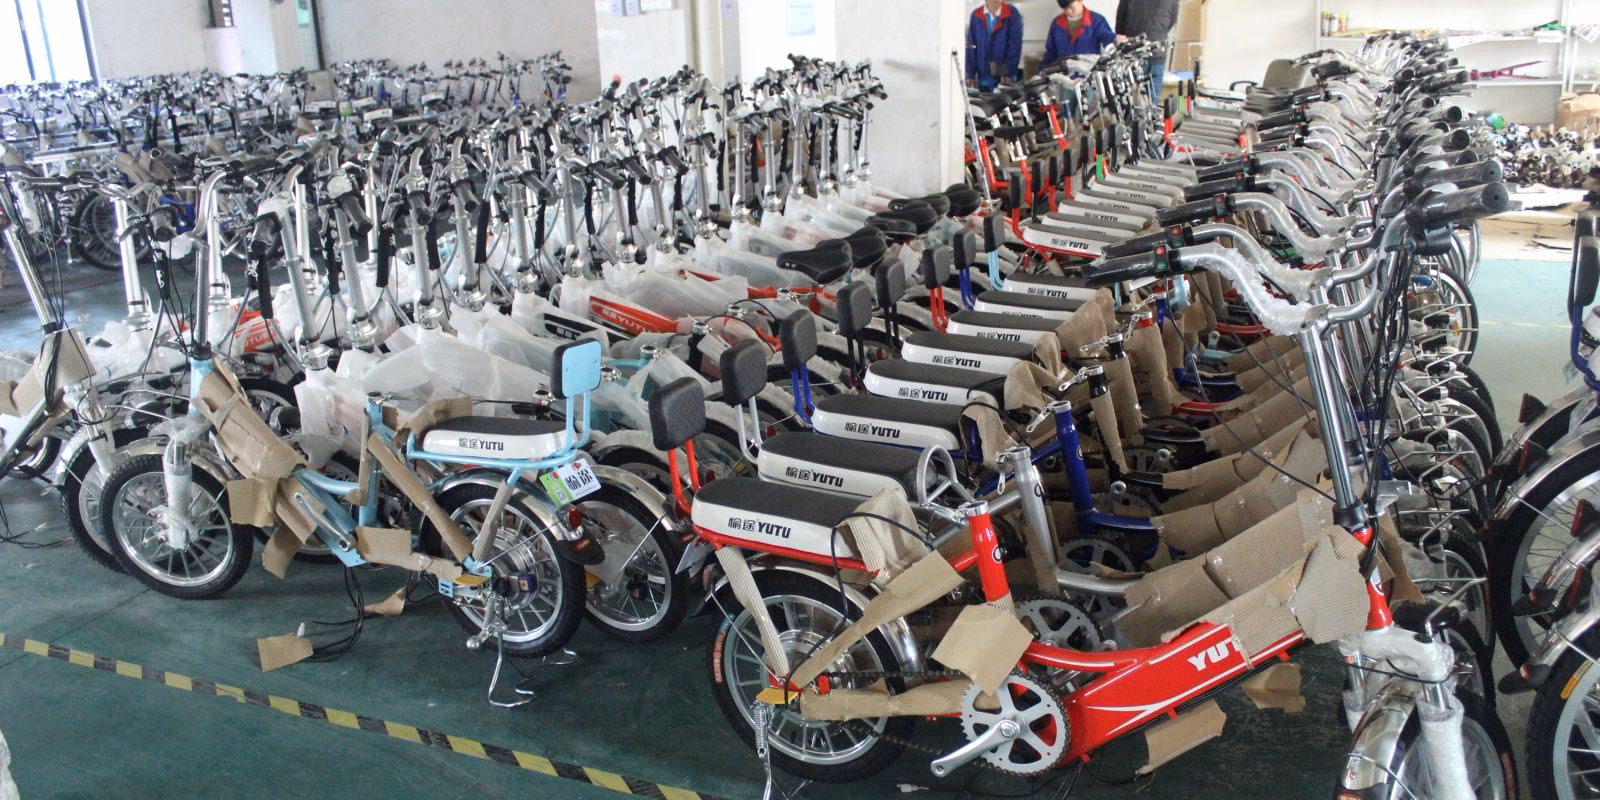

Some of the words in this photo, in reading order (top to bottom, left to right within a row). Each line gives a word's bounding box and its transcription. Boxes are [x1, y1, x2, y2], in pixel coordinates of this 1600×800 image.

[1068, 240, 1089, 250] YUTU
[1046, 289, 1068, 299] YUTU
[997, 333, 1020, 341] YUTU
[955, 357, 981, 368] YUTU
[922, 390, 948, 401] YUTU
[871, 426, 900, 438] YUTU
[480, 440, 504, 451] YUTU
[812, 472, 844, 488] YUTU
[758, 521, 791, 539] YUTU
